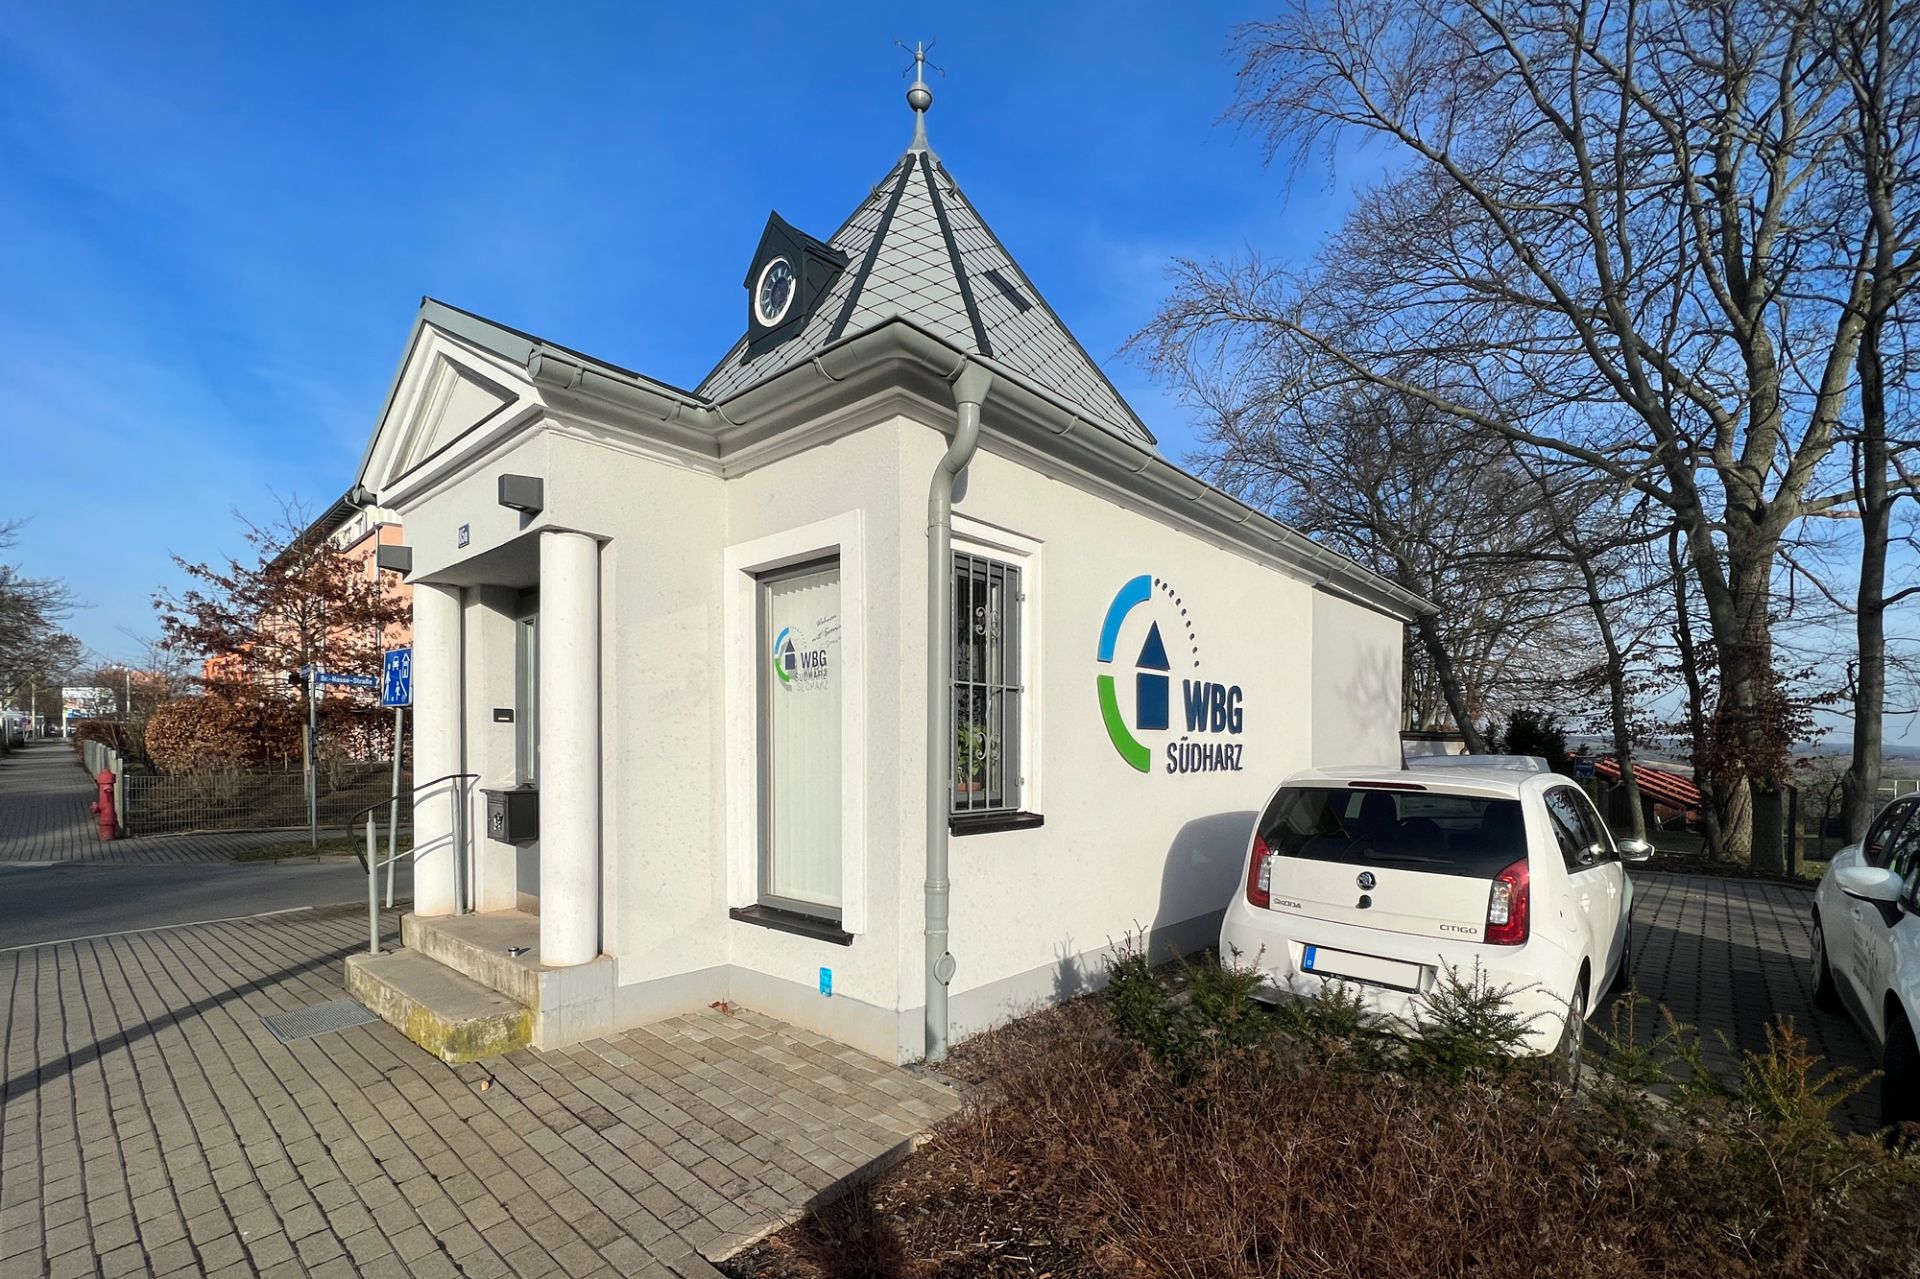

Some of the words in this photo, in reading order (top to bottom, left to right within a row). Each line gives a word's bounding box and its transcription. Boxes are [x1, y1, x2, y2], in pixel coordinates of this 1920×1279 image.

[801, 650, 827, 669] WBG
[1183, 679, 1243, 735] WBG
[1166, 736, 1243, 775] SÜDHARZ
[1440, 924, 1478, 935] CITIGO
